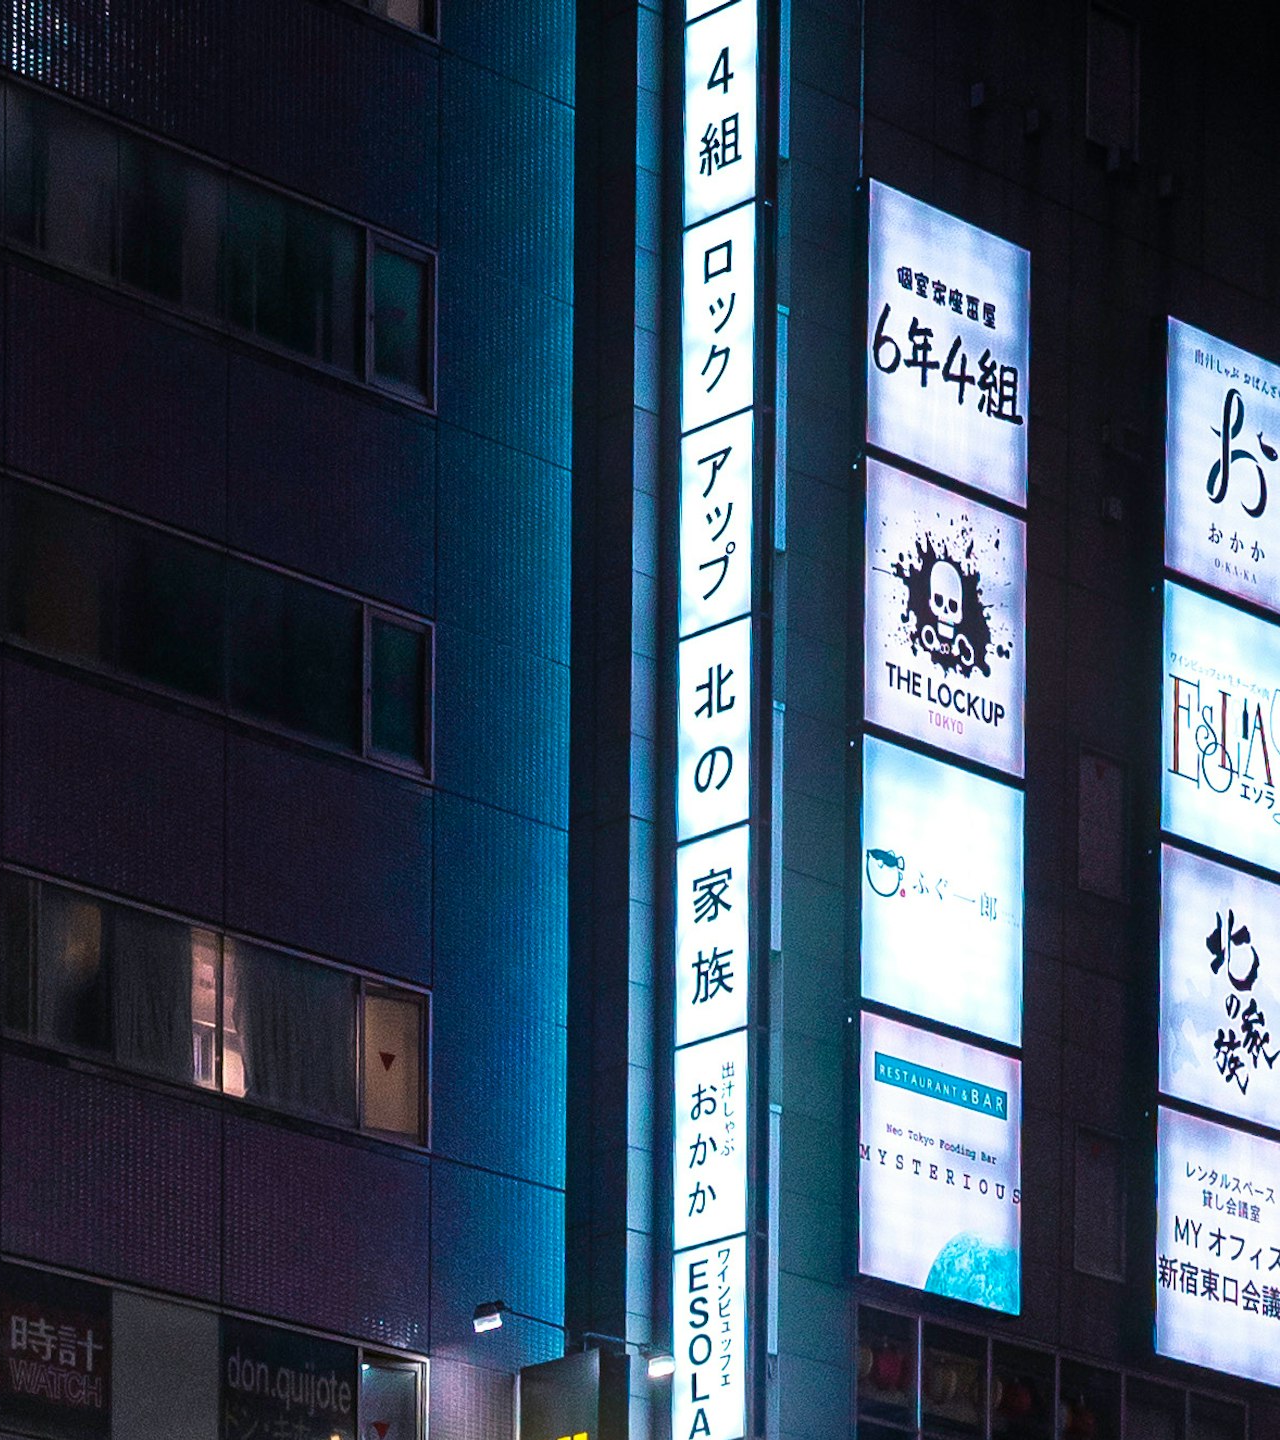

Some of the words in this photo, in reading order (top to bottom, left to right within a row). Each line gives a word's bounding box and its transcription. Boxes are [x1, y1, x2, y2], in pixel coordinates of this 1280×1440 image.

[697, 47, 742, 177] 4組
[872, 303, 1024, 427] 6年4組
[695, 238, 737, 601] ロックアップ
[1207, 521, 1267, 563] おかか
[885, 661, 923, 700] THE
[926, 682, 1006, 729] LOCKUP
[927, 708, 965, 736] TOKYO
[1239, 781, 1276, 813] エソラ
[690, 664, 738, 1007] 北の家族
[912, 870, 998, 922] ふぐ一郎
[1205, 909, 1279, 1095] 北の家族
[719, 1060, 738, 1158] 出汁しゃぶ
[878, 1061, 958, 1099] RESTAURANT
[970, 1085, 1005, 1113] BAR
[687, 1082, 720, 1216] おかか
[858, 1142, 1023, 1205] MYSTERIOUS
[885, 1122, 904, 1137] Neo
[907, 1128, 935, 1148] Tokyo
[938, 1137, 977, 1162] Fooding
[980, 1151, 998, 1166] Bar
[1184, 1159, 1276, 1205] レンタルスペース
[1202, 1187, 1261, 1224] 貸し会議室
[1174, 1214, 1202, 1250] MY
[9, 1314, 104, 1372] 時計
[715, 1249, 733, 1389] ワインビュッフェ
[8, 1357, 103, 1408] WATCH
[227, 1346, 352, 1417] don.quijote
